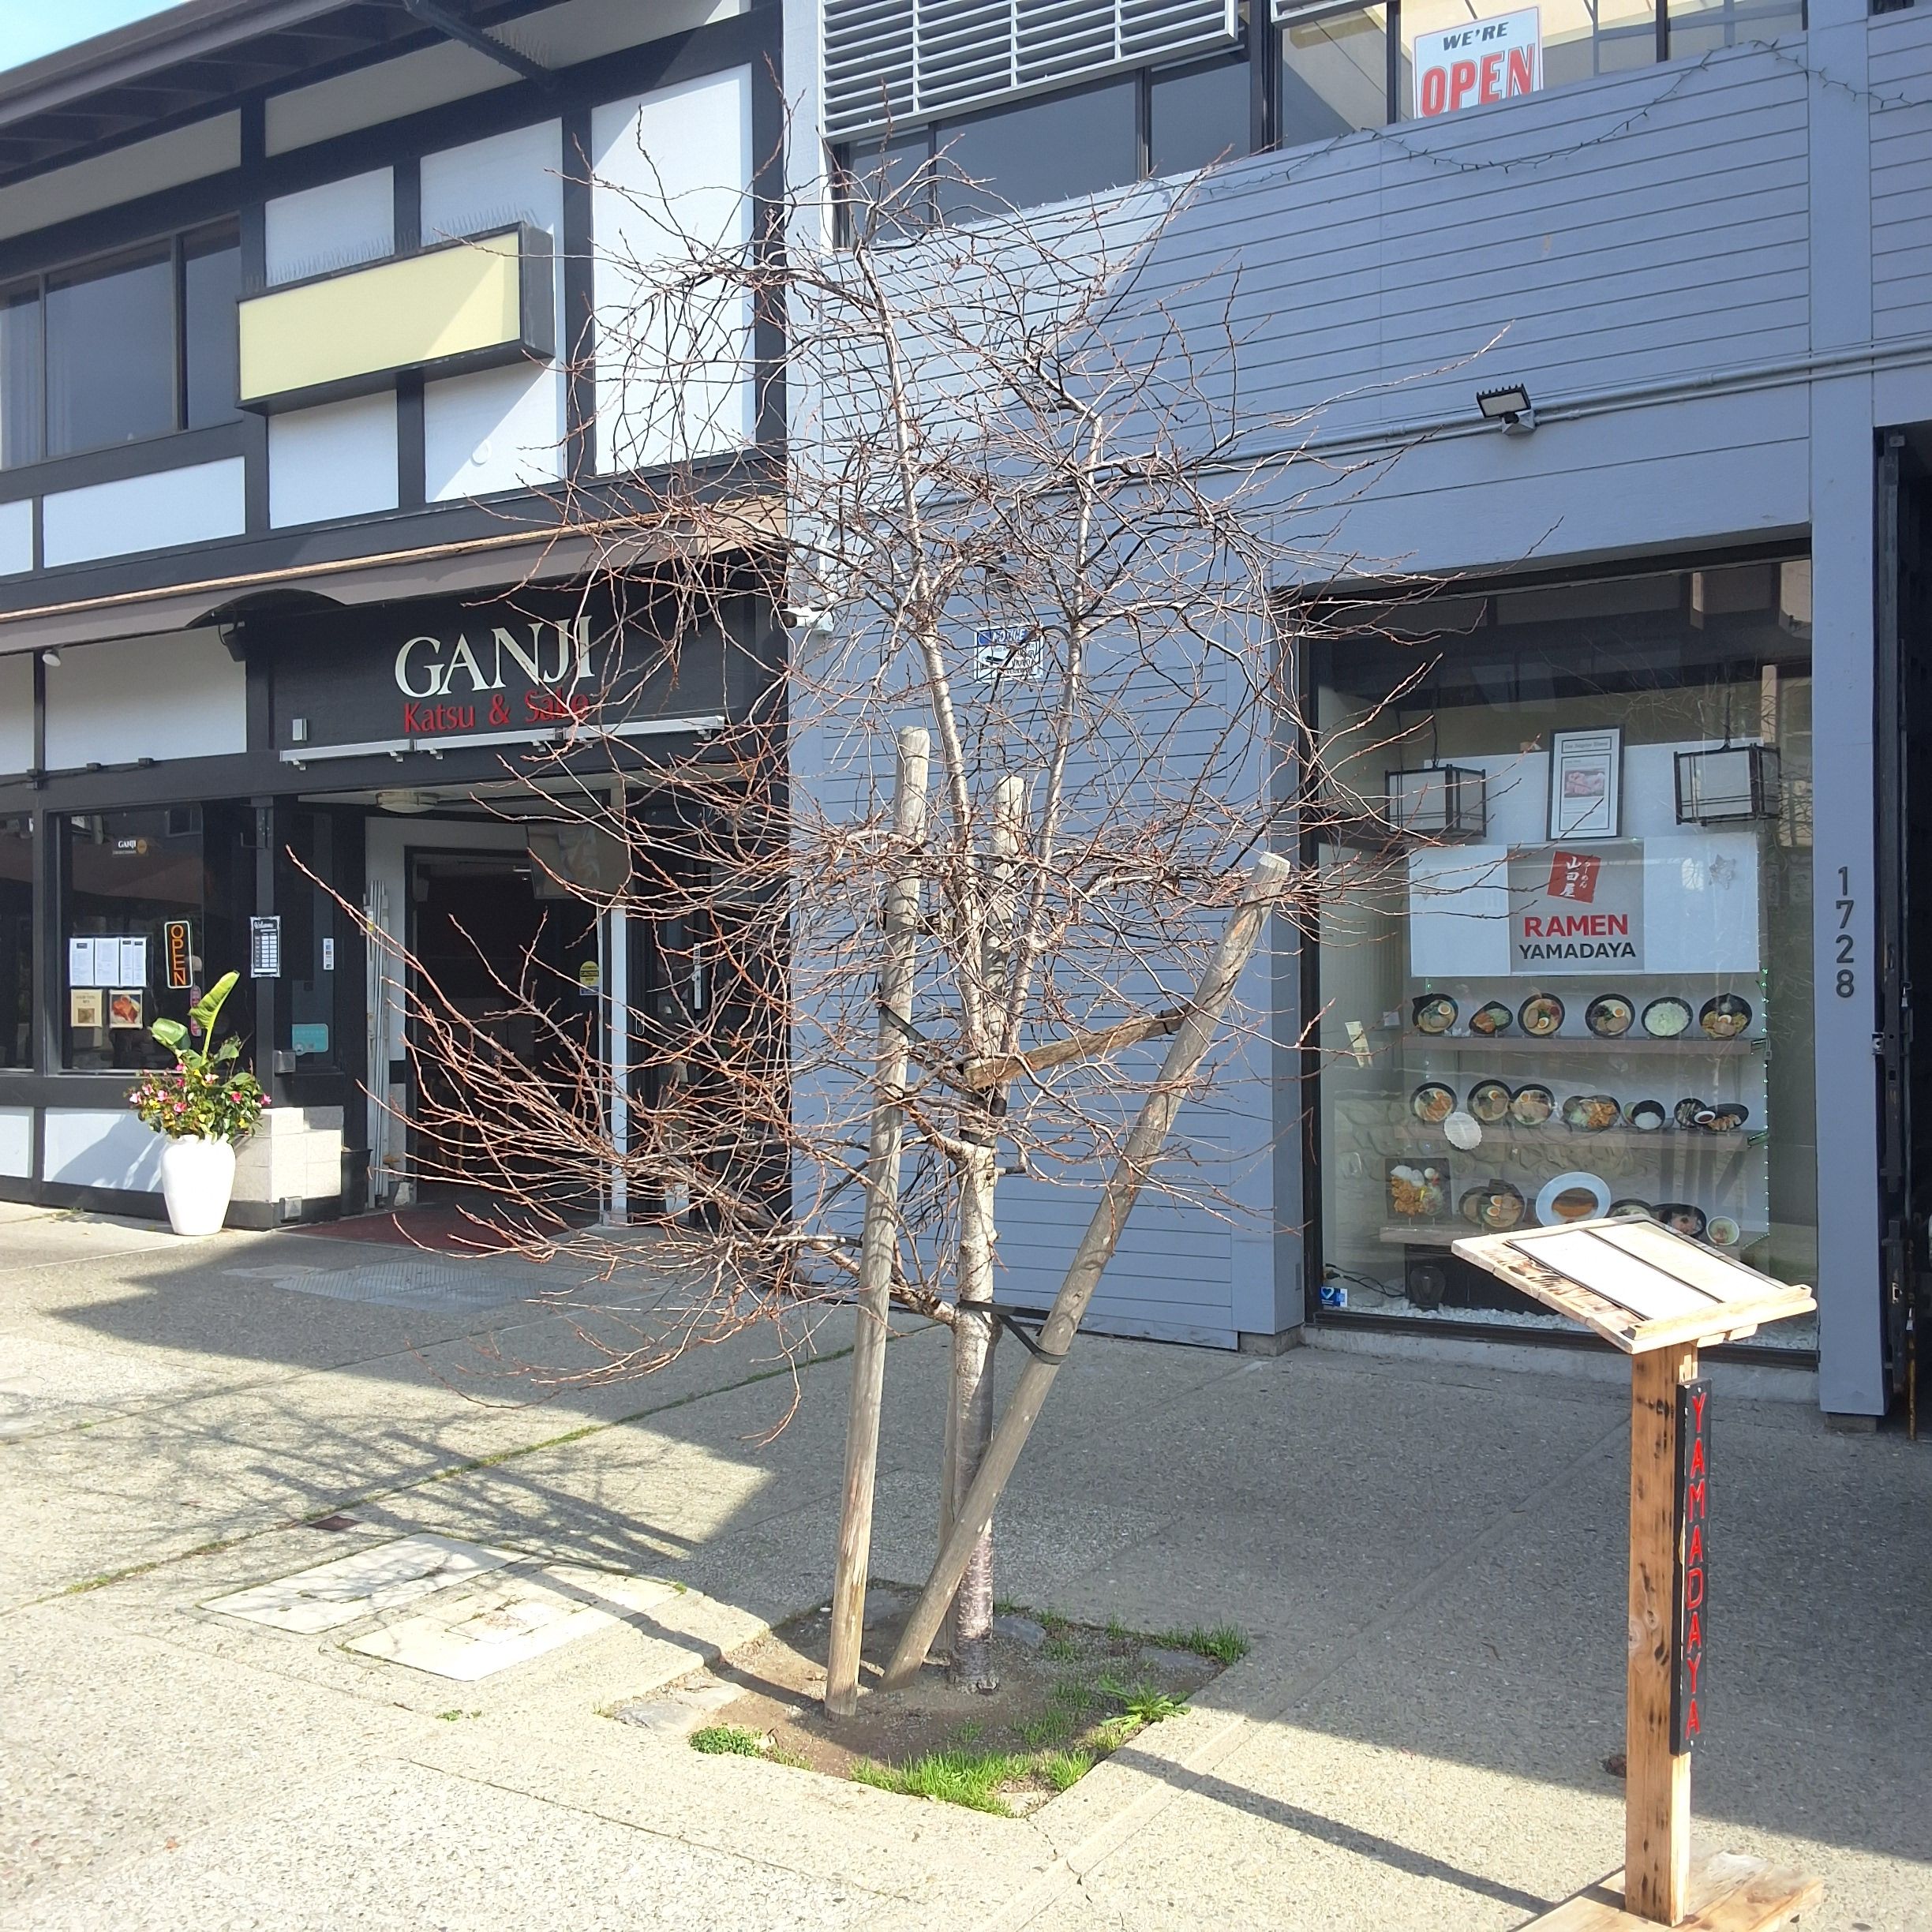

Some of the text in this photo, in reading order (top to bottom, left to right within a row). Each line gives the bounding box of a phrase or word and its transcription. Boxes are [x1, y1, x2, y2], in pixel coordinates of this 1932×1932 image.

[1443, 21, 1509, 51] WE'RE
[1420, 43, 1536, 118] OPEN
[395, 615, 596, 698] GANJI
[403, 700, 475, 734] Katsu
[488, 693, 511, 726] &
[170, 924, 186, 987] OPEN
[1518, 942, 1637, 960] YAMADAYA
[1523, 914, 1629, 938] RAMEN
[1835, 866, 1855, 999] 1728
[1684, 1391, 1707, 1741] YAMADAYA
